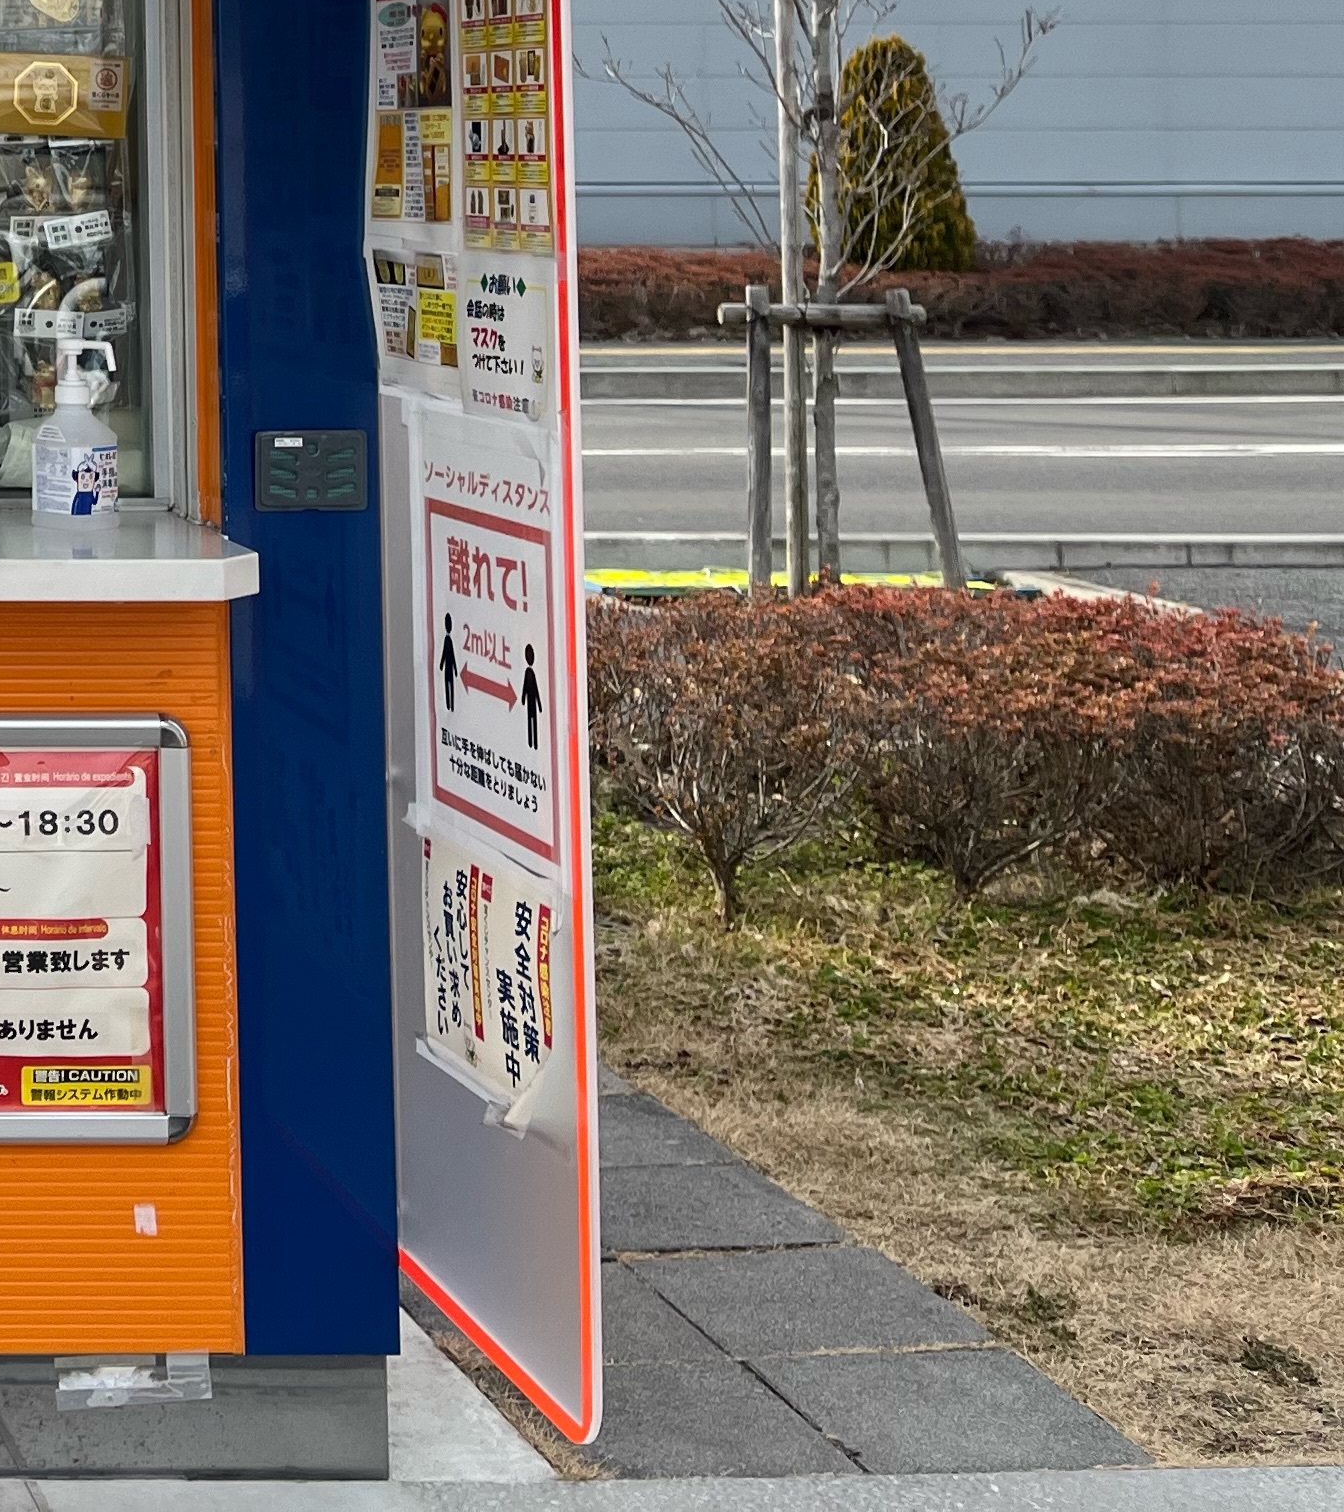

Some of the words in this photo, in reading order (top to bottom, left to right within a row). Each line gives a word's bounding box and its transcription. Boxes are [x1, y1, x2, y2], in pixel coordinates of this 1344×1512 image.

[489, 274, 516, 295] お願い
[467, 299, 504, 321] 会話の時は
[471, 327, 506, 351] マスクを
[472, 353, 524, 375] つけて下さい!
[424, 461, 550, 514] ソーシャルディスタンス
[447, 536, 528, 612] 離れて!
[463, 623, 511, 670] 2m以上
[80, 773, 89, 781] de
[441, 727, 546, 791] 互いに手を伸ばしても届かない
[449, 756, 538, 812] 十分な距離をとりましょう
[68, 925, 76, 934] de
[443, 881, 462, 1028] お買い求め
[456, 870, 469, 990] 安心して
[434, 926, 449, 1035] ください
[515, 901, 540, 1064] 安全対策
[496, 968, 521, 1087] 実施中
[31, 1089, 141, 1100] 警報システム作動中
[34, 1070, 64, 1082] 警告!
[71, 1070, 138, 1082] CAUTION
